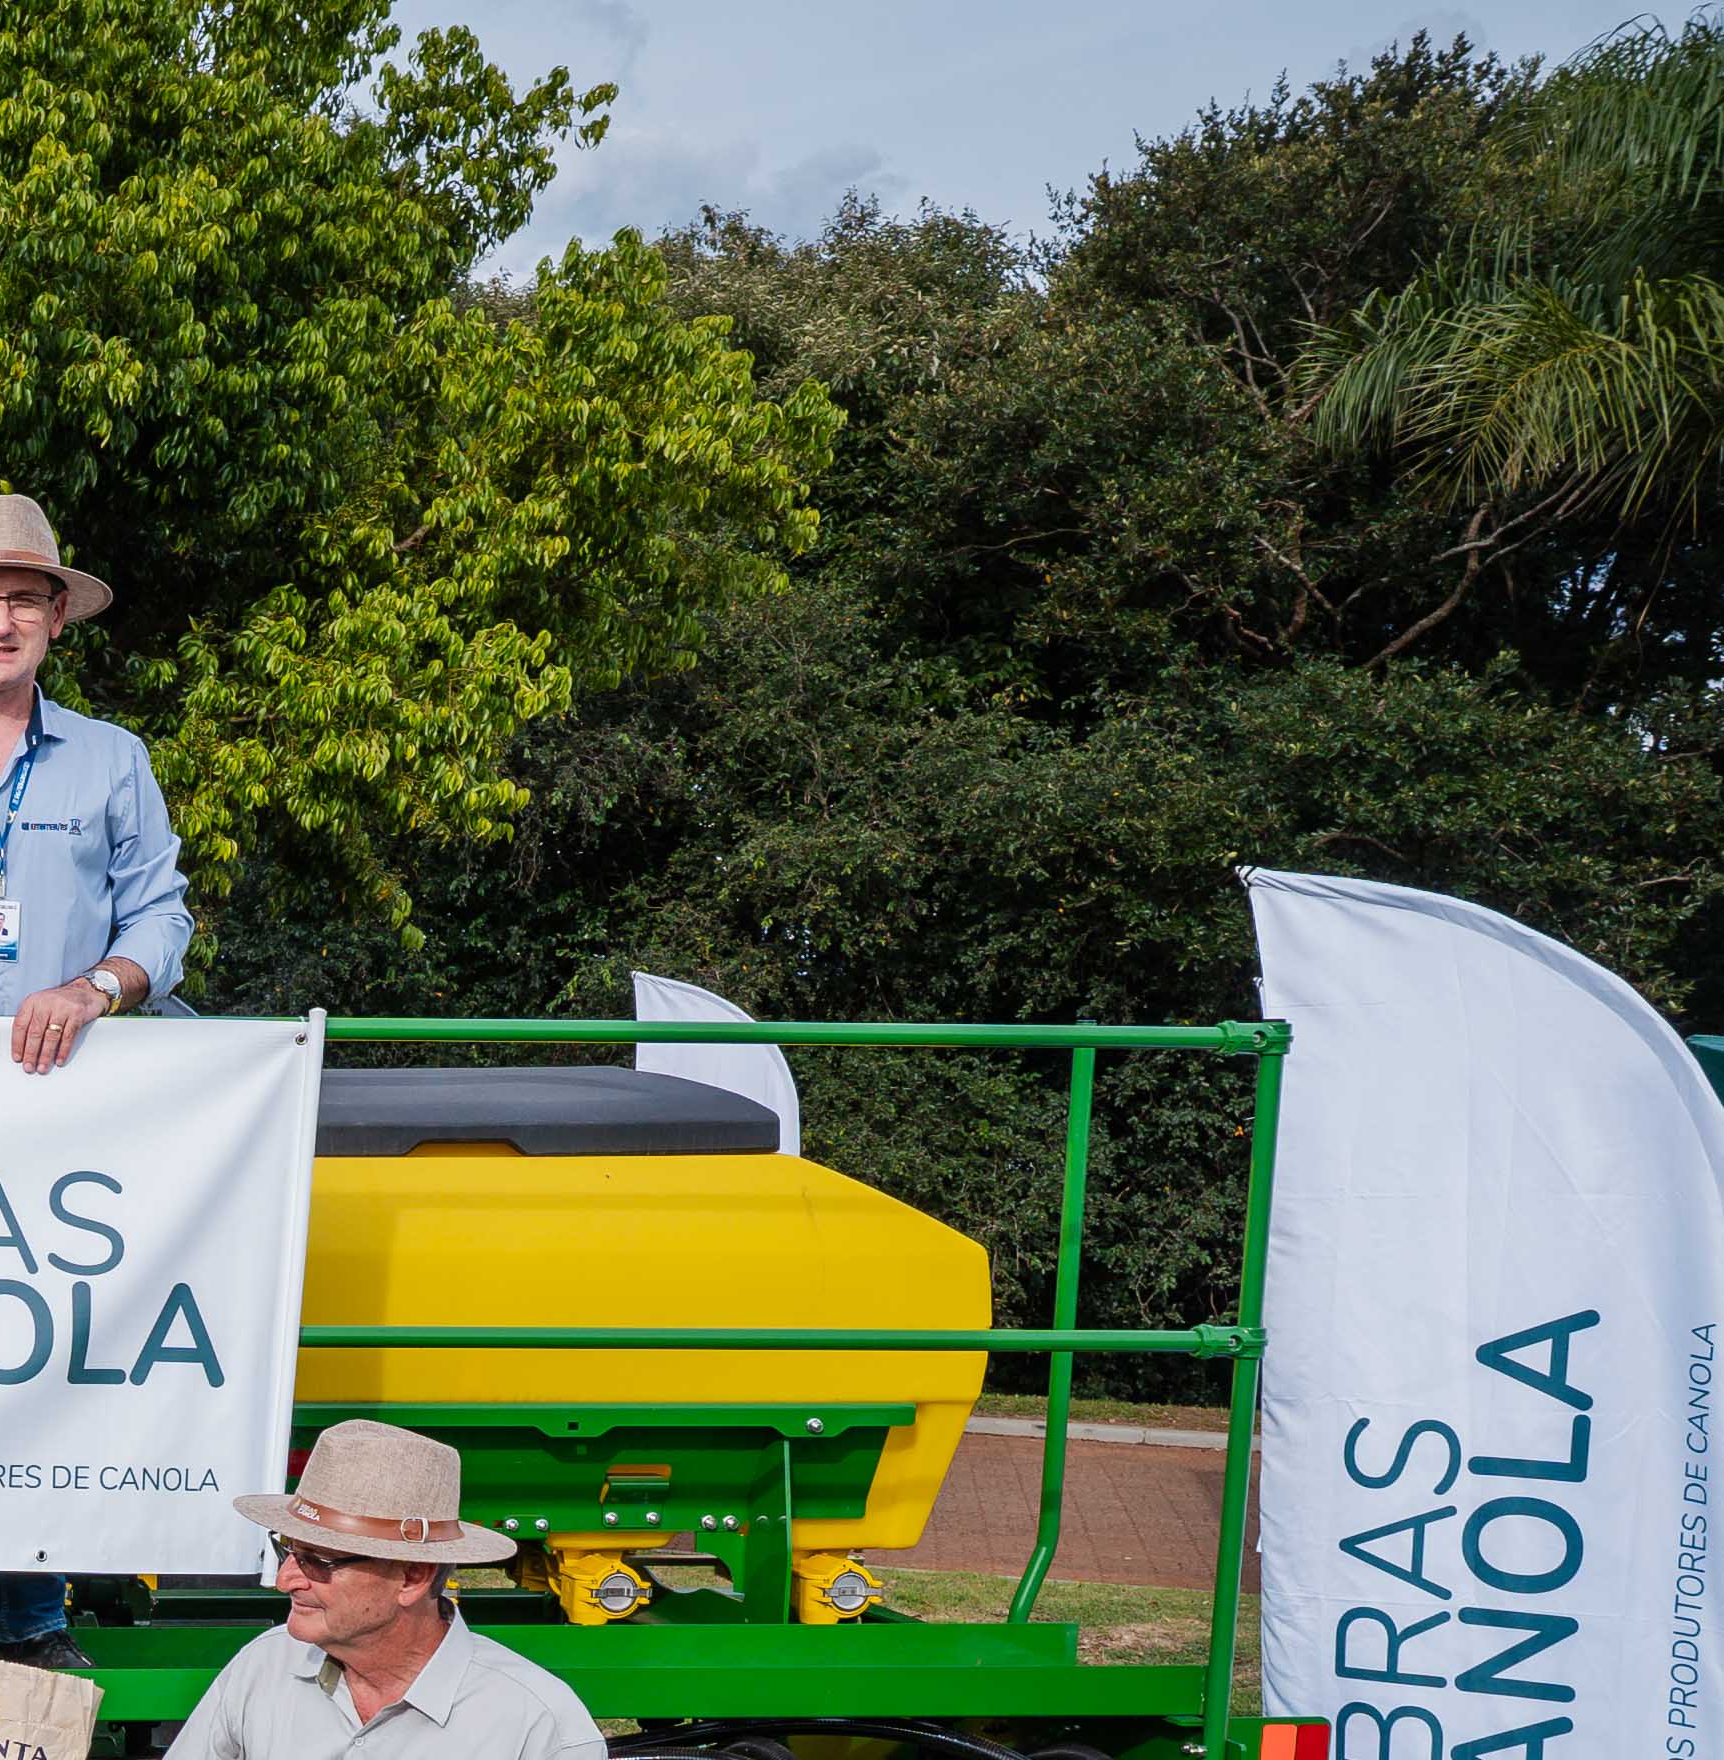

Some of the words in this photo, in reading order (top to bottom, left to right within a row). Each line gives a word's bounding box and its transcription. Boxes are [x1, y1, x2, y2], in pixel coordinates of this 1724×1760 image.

[1685, 1322, 1718, 1454] CANOLA
[51, 1465, 91, 1491] DE
[99, 1467, 220, 1493] CANOLA
[1683, 1460, 1709, 1507] DE
[1667, 1511, 1708, 1730] PRODUTORES
